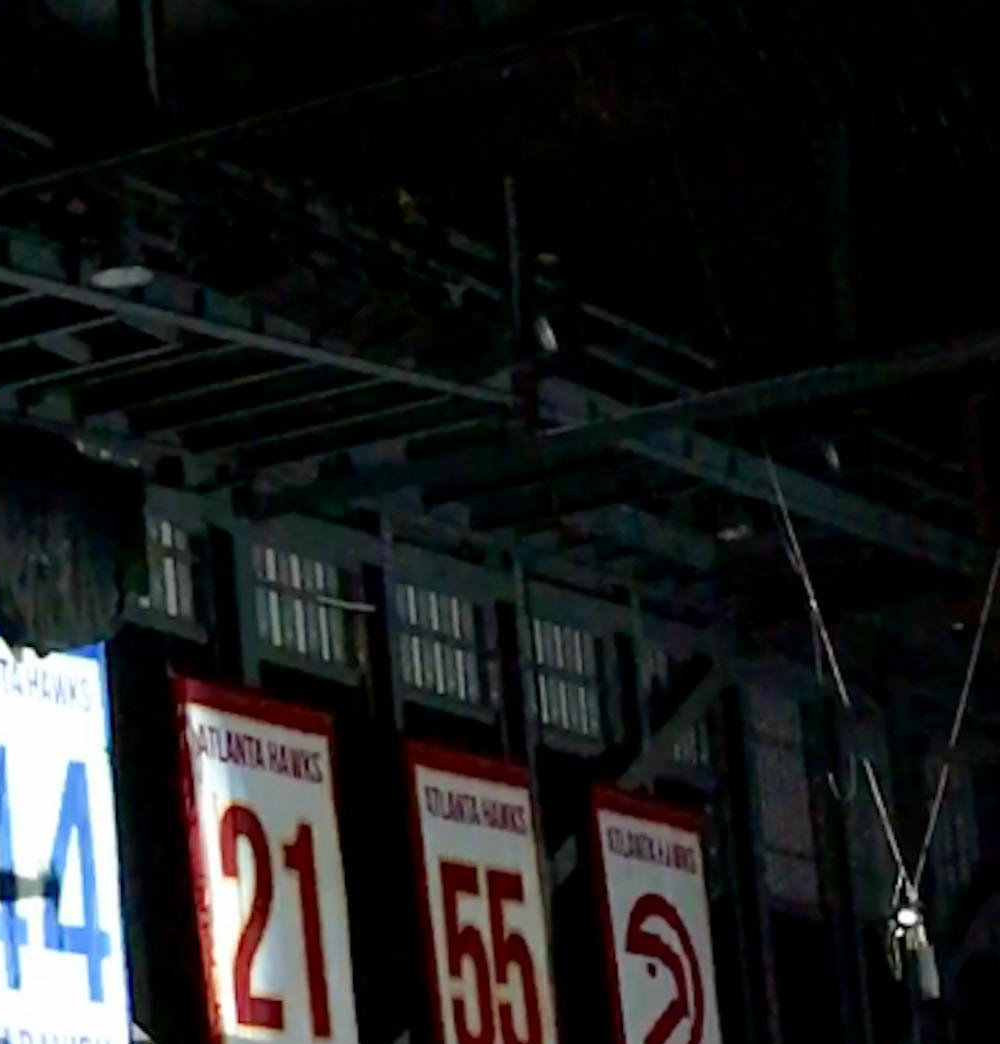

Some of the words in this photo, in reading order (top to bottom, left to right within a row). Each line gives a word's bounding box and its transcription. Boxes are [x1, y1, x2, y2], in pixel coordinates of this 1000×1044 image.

[196, 723, 265, 771] ATLANTA
[267, 742, 324, 785] HAWKS
[218, 803, 334, 1040] 21
